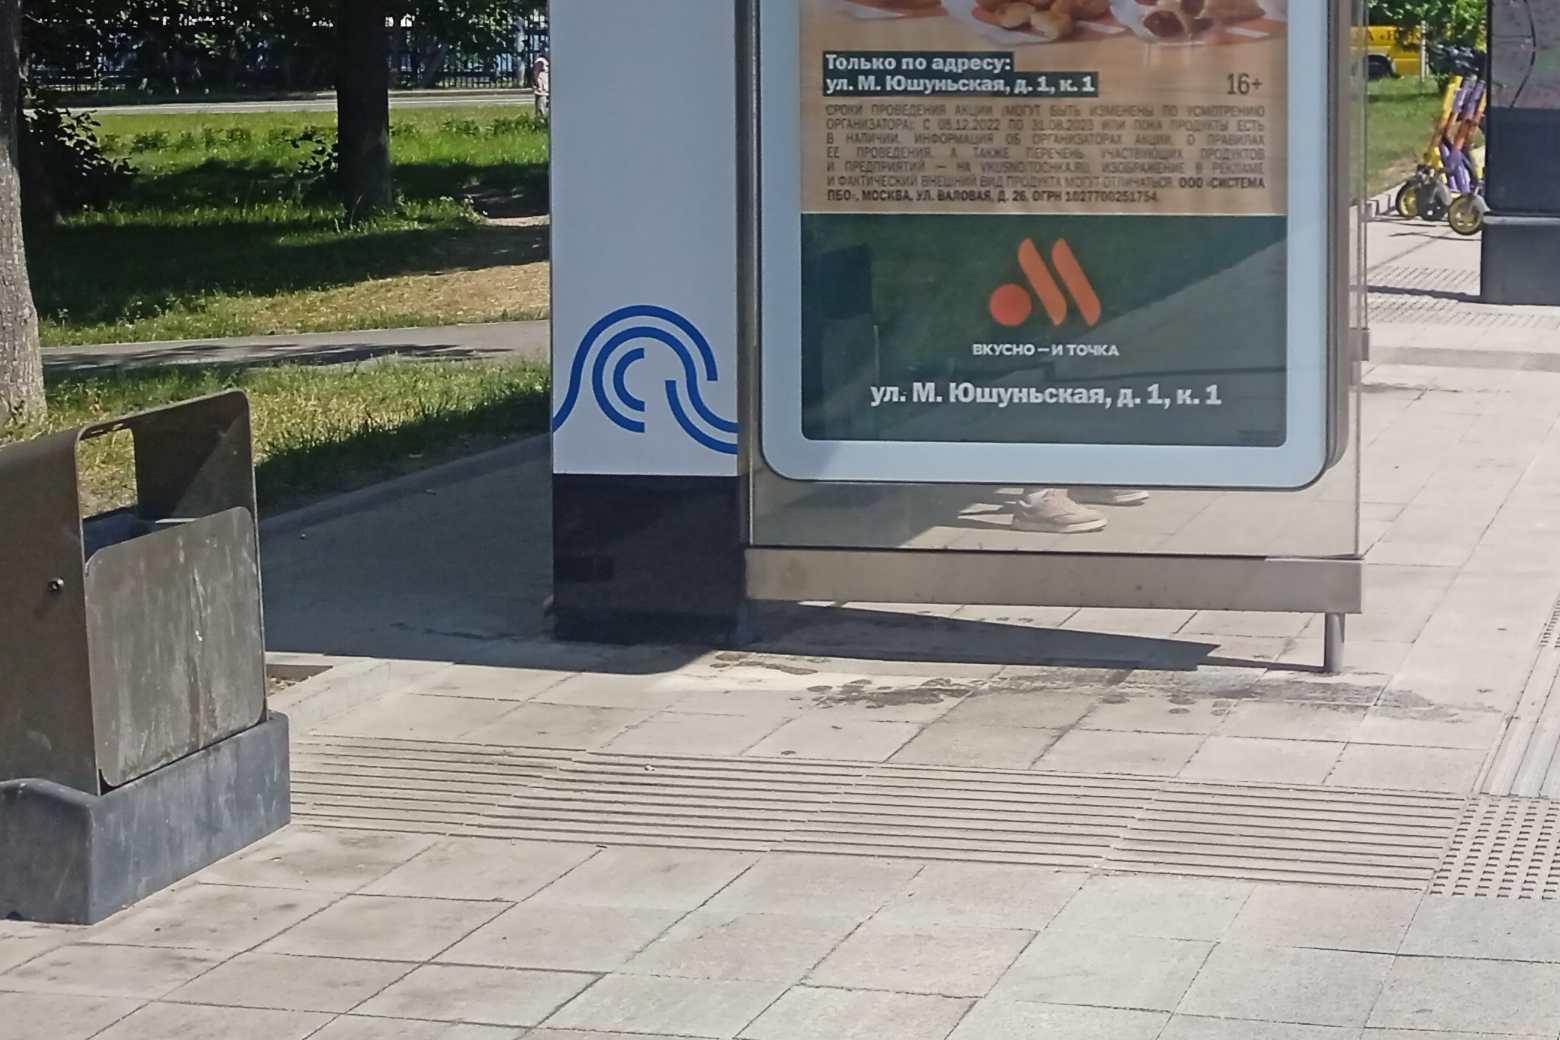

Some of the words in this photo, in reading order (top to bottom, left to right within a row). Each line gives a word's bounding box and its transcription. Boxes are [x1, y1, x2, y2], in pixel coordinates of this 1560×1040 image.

[825, 53, 896, 70] Только
[901, 58, 927, 70] по
[932, 58, 1011, 74] адресу:
[826, 79, 854, 94] ул.
[858, 75, 881, 91] М.
[885, 75, 1011, 94] Юшуньская,
[1013, 80, 1033, 94] д.
[1037, 76, 1056, 94] 1,
[1060, 80, 1079, 92] к.
[1081, 76, 1095, 92] 1
[1226, 72, 1263, 96] 16+
[826, 133, 834, 144] В
[1178, 177, 1203, 189] ООО
[1032, 191, 1062, 203] ОГРН
[972, 343, 1036, 356] ВКУСНО
[1051, 344, 1063, 356] И
[1066, 344, 1120, 356] ТОЧКА
[870, 386, 906, 407] ул.
[912, 382, 943, 403] М.
[949, 382, 1112, 409] Юшуньская,
[1117, 388, 1141, 408] д.
[1147, 383, 1171, 409] 1,
[1177, 389, 1200, 405] к.
[1205, 384, 1222, 405] 1
